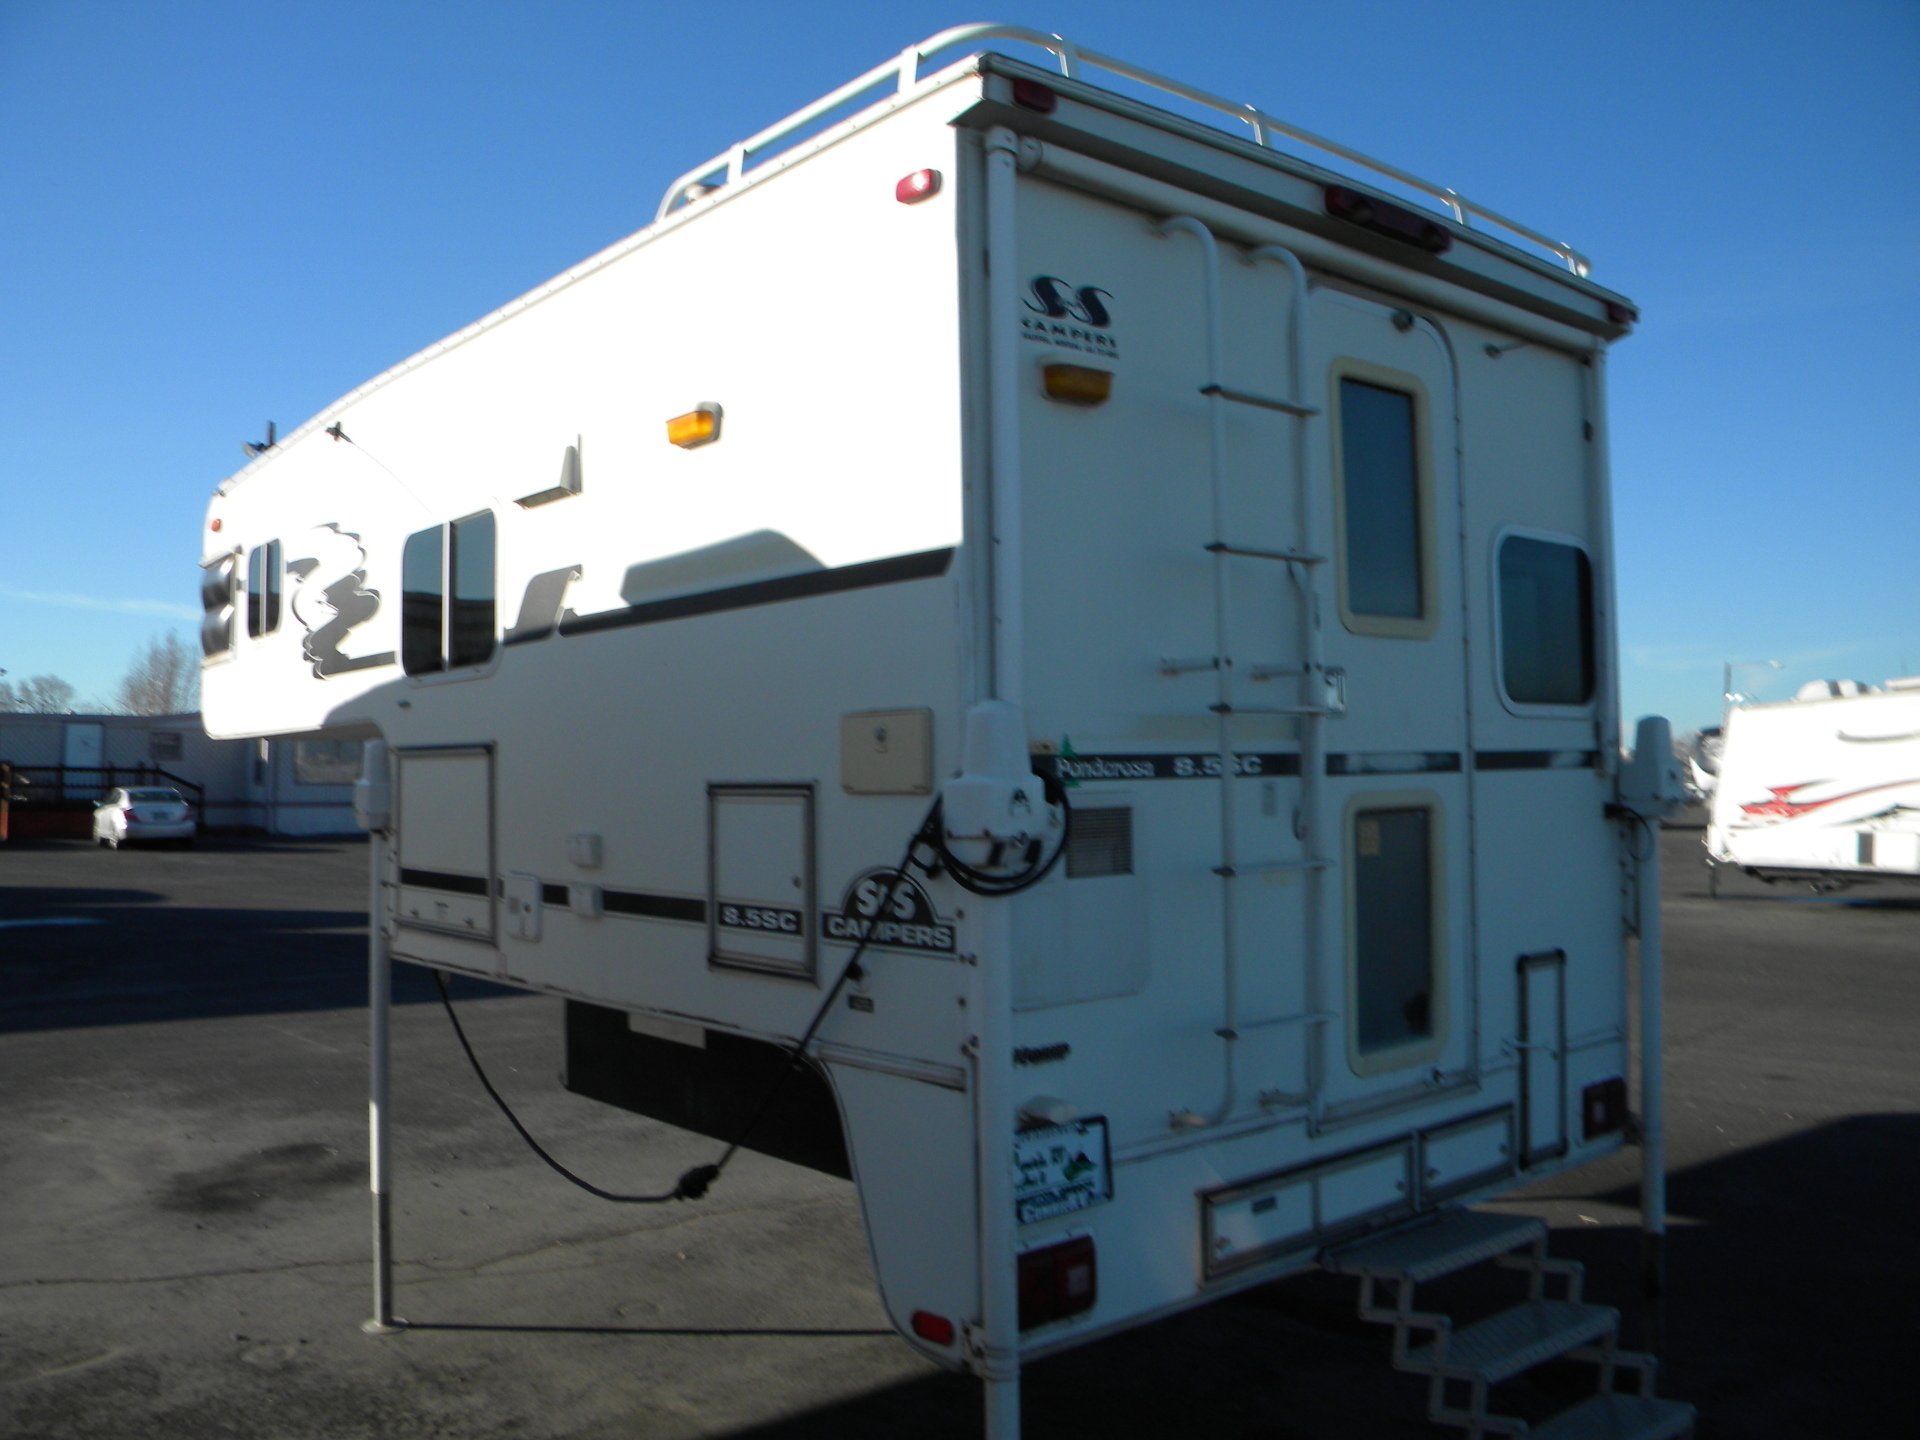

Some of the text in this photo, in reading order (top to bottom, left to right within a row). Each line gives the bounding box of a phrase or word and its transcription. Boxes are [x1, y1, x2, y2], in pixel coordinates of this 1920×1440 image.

[1019, 318, 1117, 348] CAMPERS
[1055, 757, 1155, 777] Ponderosa
[722, 905, 798, 932] 8.5SC
[827, 916, 953, 948] CAMPERS
